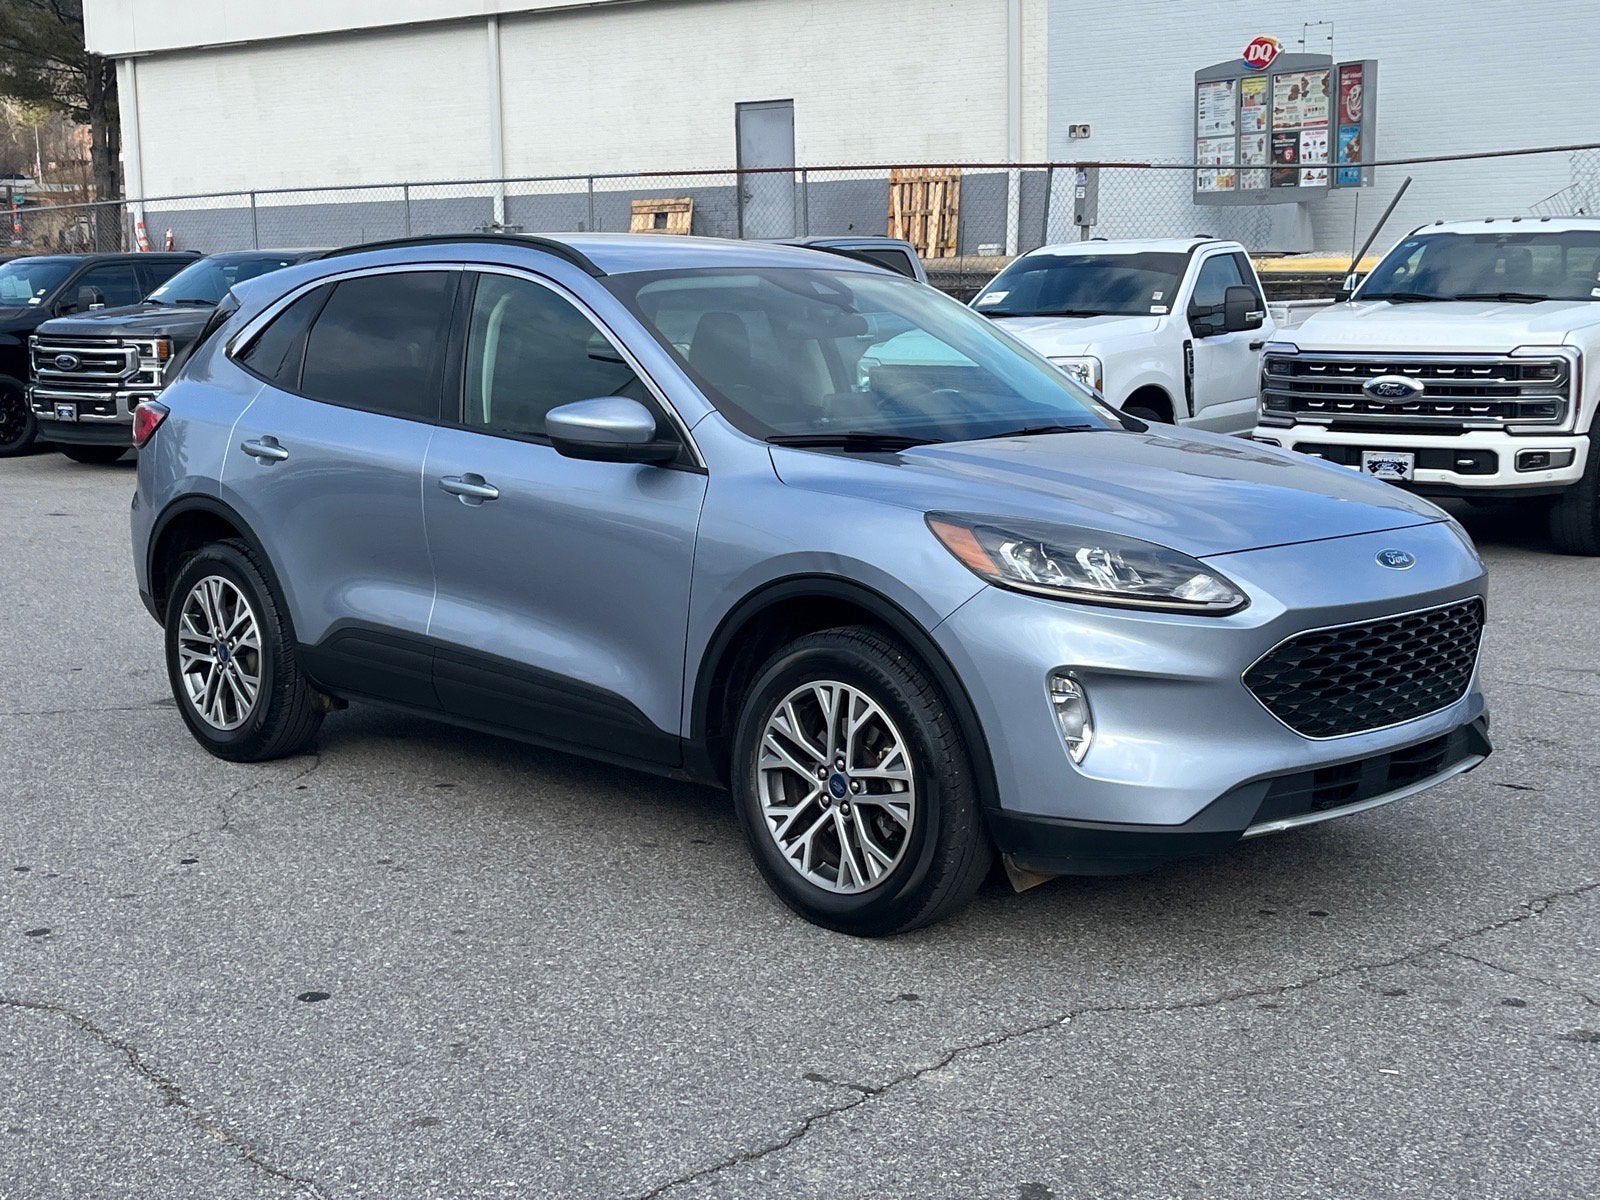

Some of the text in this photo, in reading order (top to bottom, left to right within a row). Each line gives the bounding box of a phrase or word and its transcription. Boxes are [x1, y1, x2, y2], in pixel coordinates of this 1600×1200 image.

[1248, 43, 1274, 62] DQ
[1377, 382, 1406, 396] Ford
[1385, 551, 1409, 565] Ford
